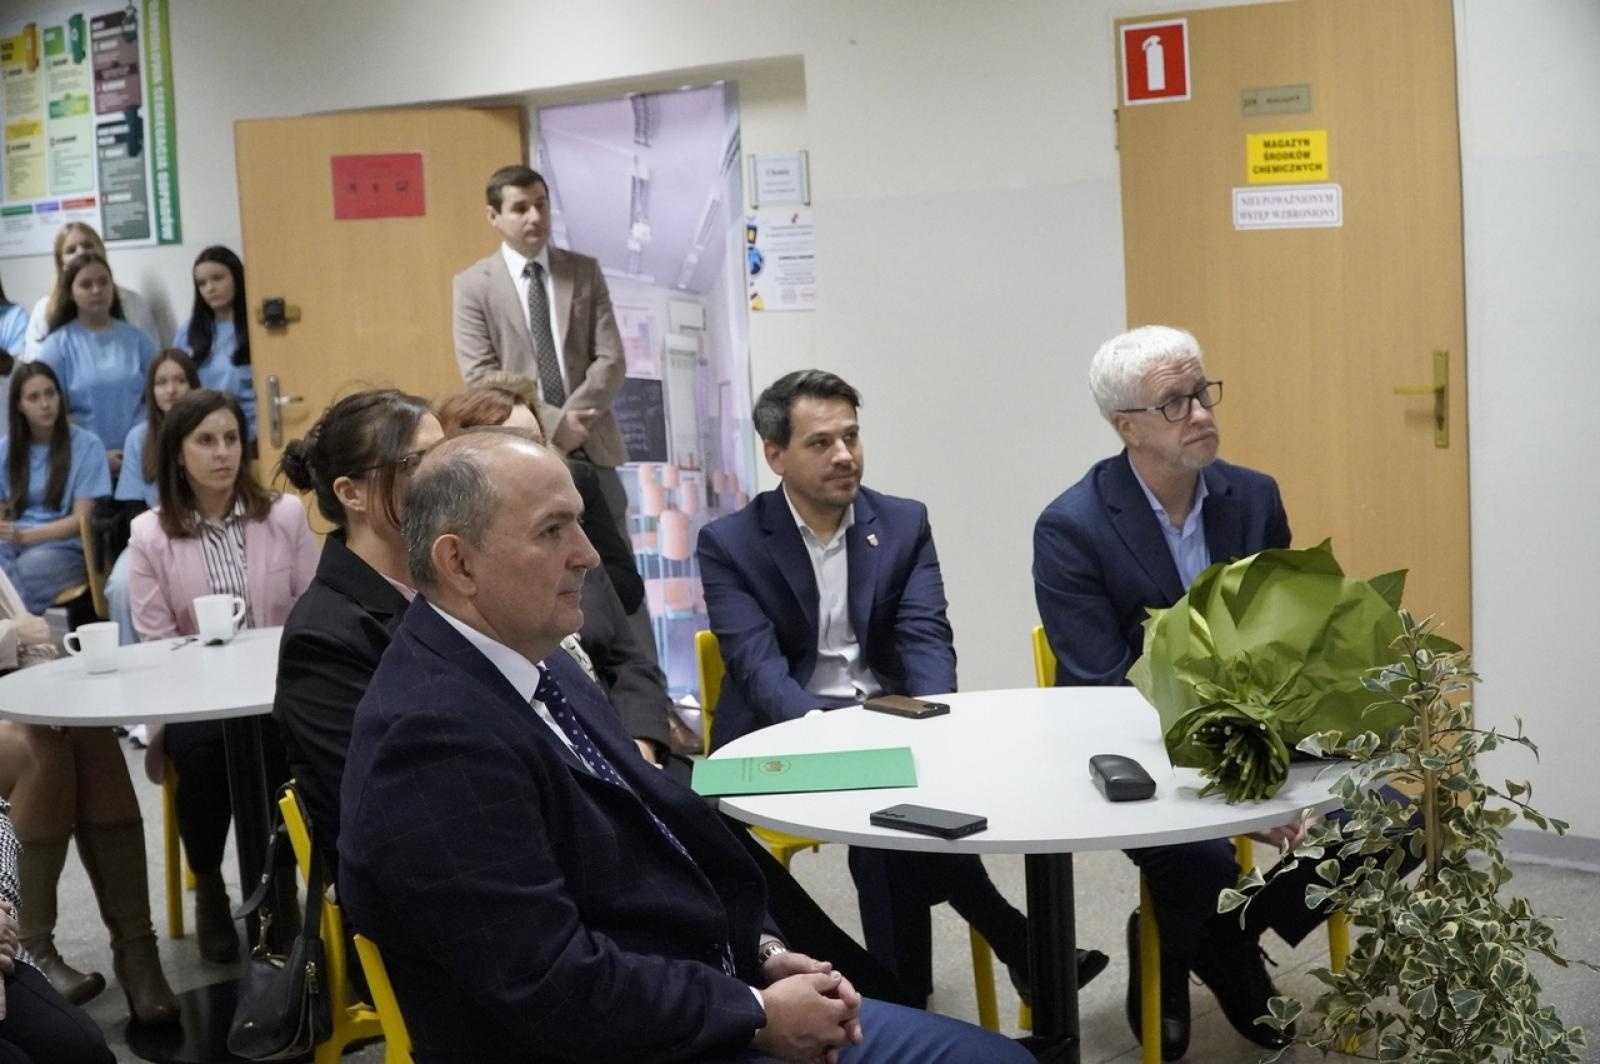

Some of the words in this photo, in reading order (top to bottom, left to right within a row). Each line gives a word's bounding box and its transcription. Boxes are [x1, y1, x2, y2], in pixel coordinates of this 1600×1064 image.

[1263, 138, 1310, 148] MAGAZYN
[1263, 150, 1310, 161] ŚRODKÓW
[1253, 163, 1322, 174] CHEMICZNYCH
[1240, 193, 1333, 205] NIEUPOWAŻNIONYM
[1239, 210, 1269, 221] WSTĘP
[1271, 209, 1335, 219] WZBRONIONY
